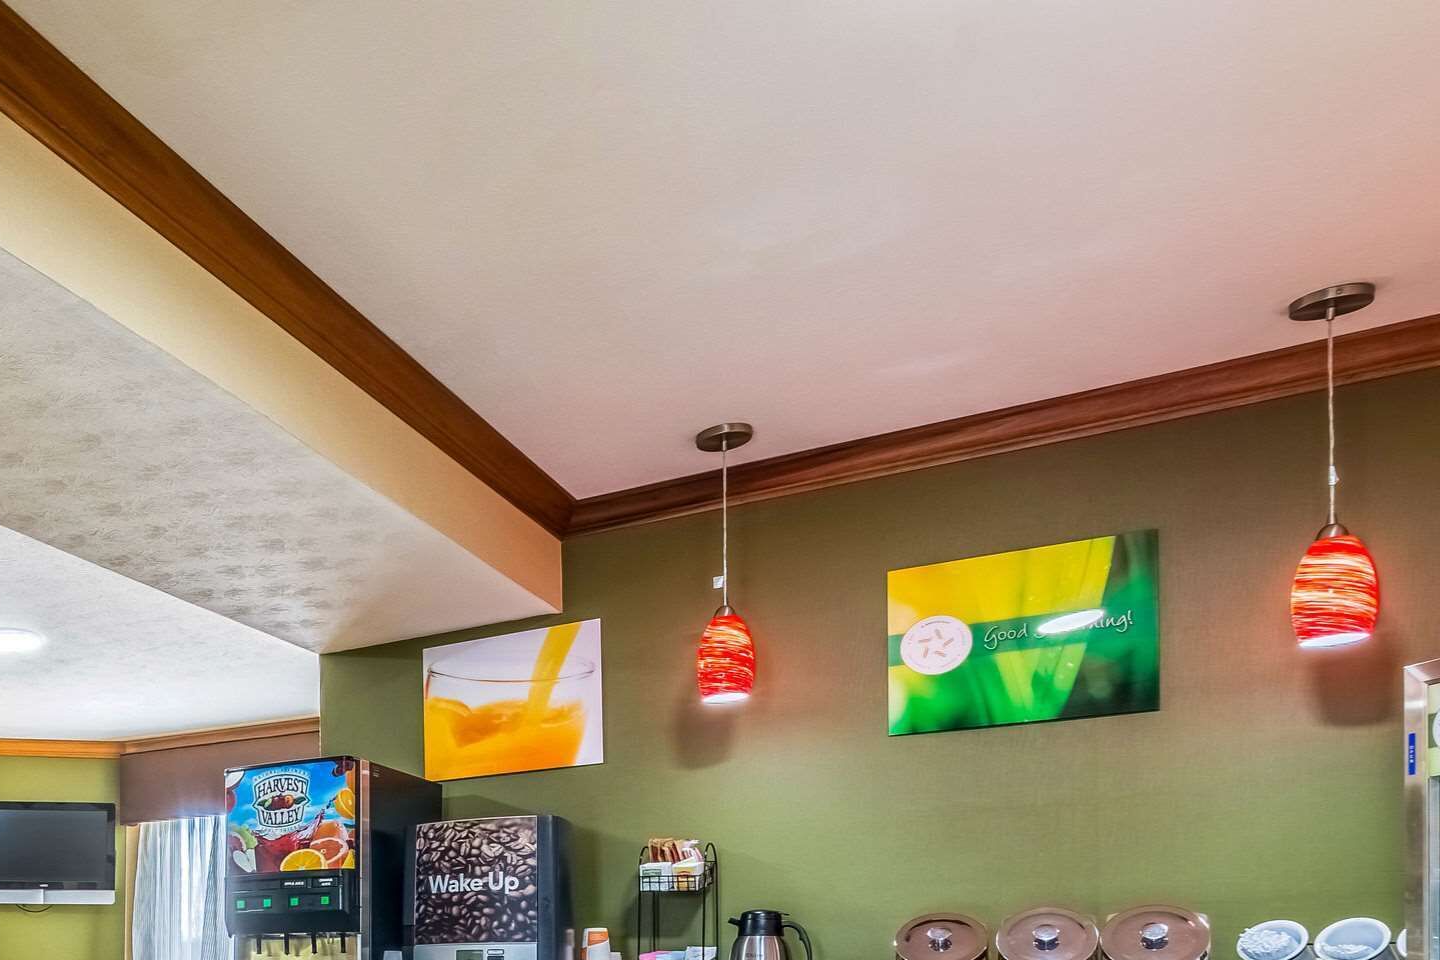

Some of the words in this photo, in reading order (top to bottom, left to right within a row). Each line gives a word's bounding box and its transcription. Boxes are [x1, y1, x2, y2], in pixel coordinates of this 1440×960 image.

[984, 623, 1028, 650] Good
[1034, 610, 1133, 639] ing!
[257, 777, 306, 800] HARVEST
[261, 806, 301, 826] VALLEY
[428, 873, 483, 894] Wake
[488, 871, 520, 895] Up
